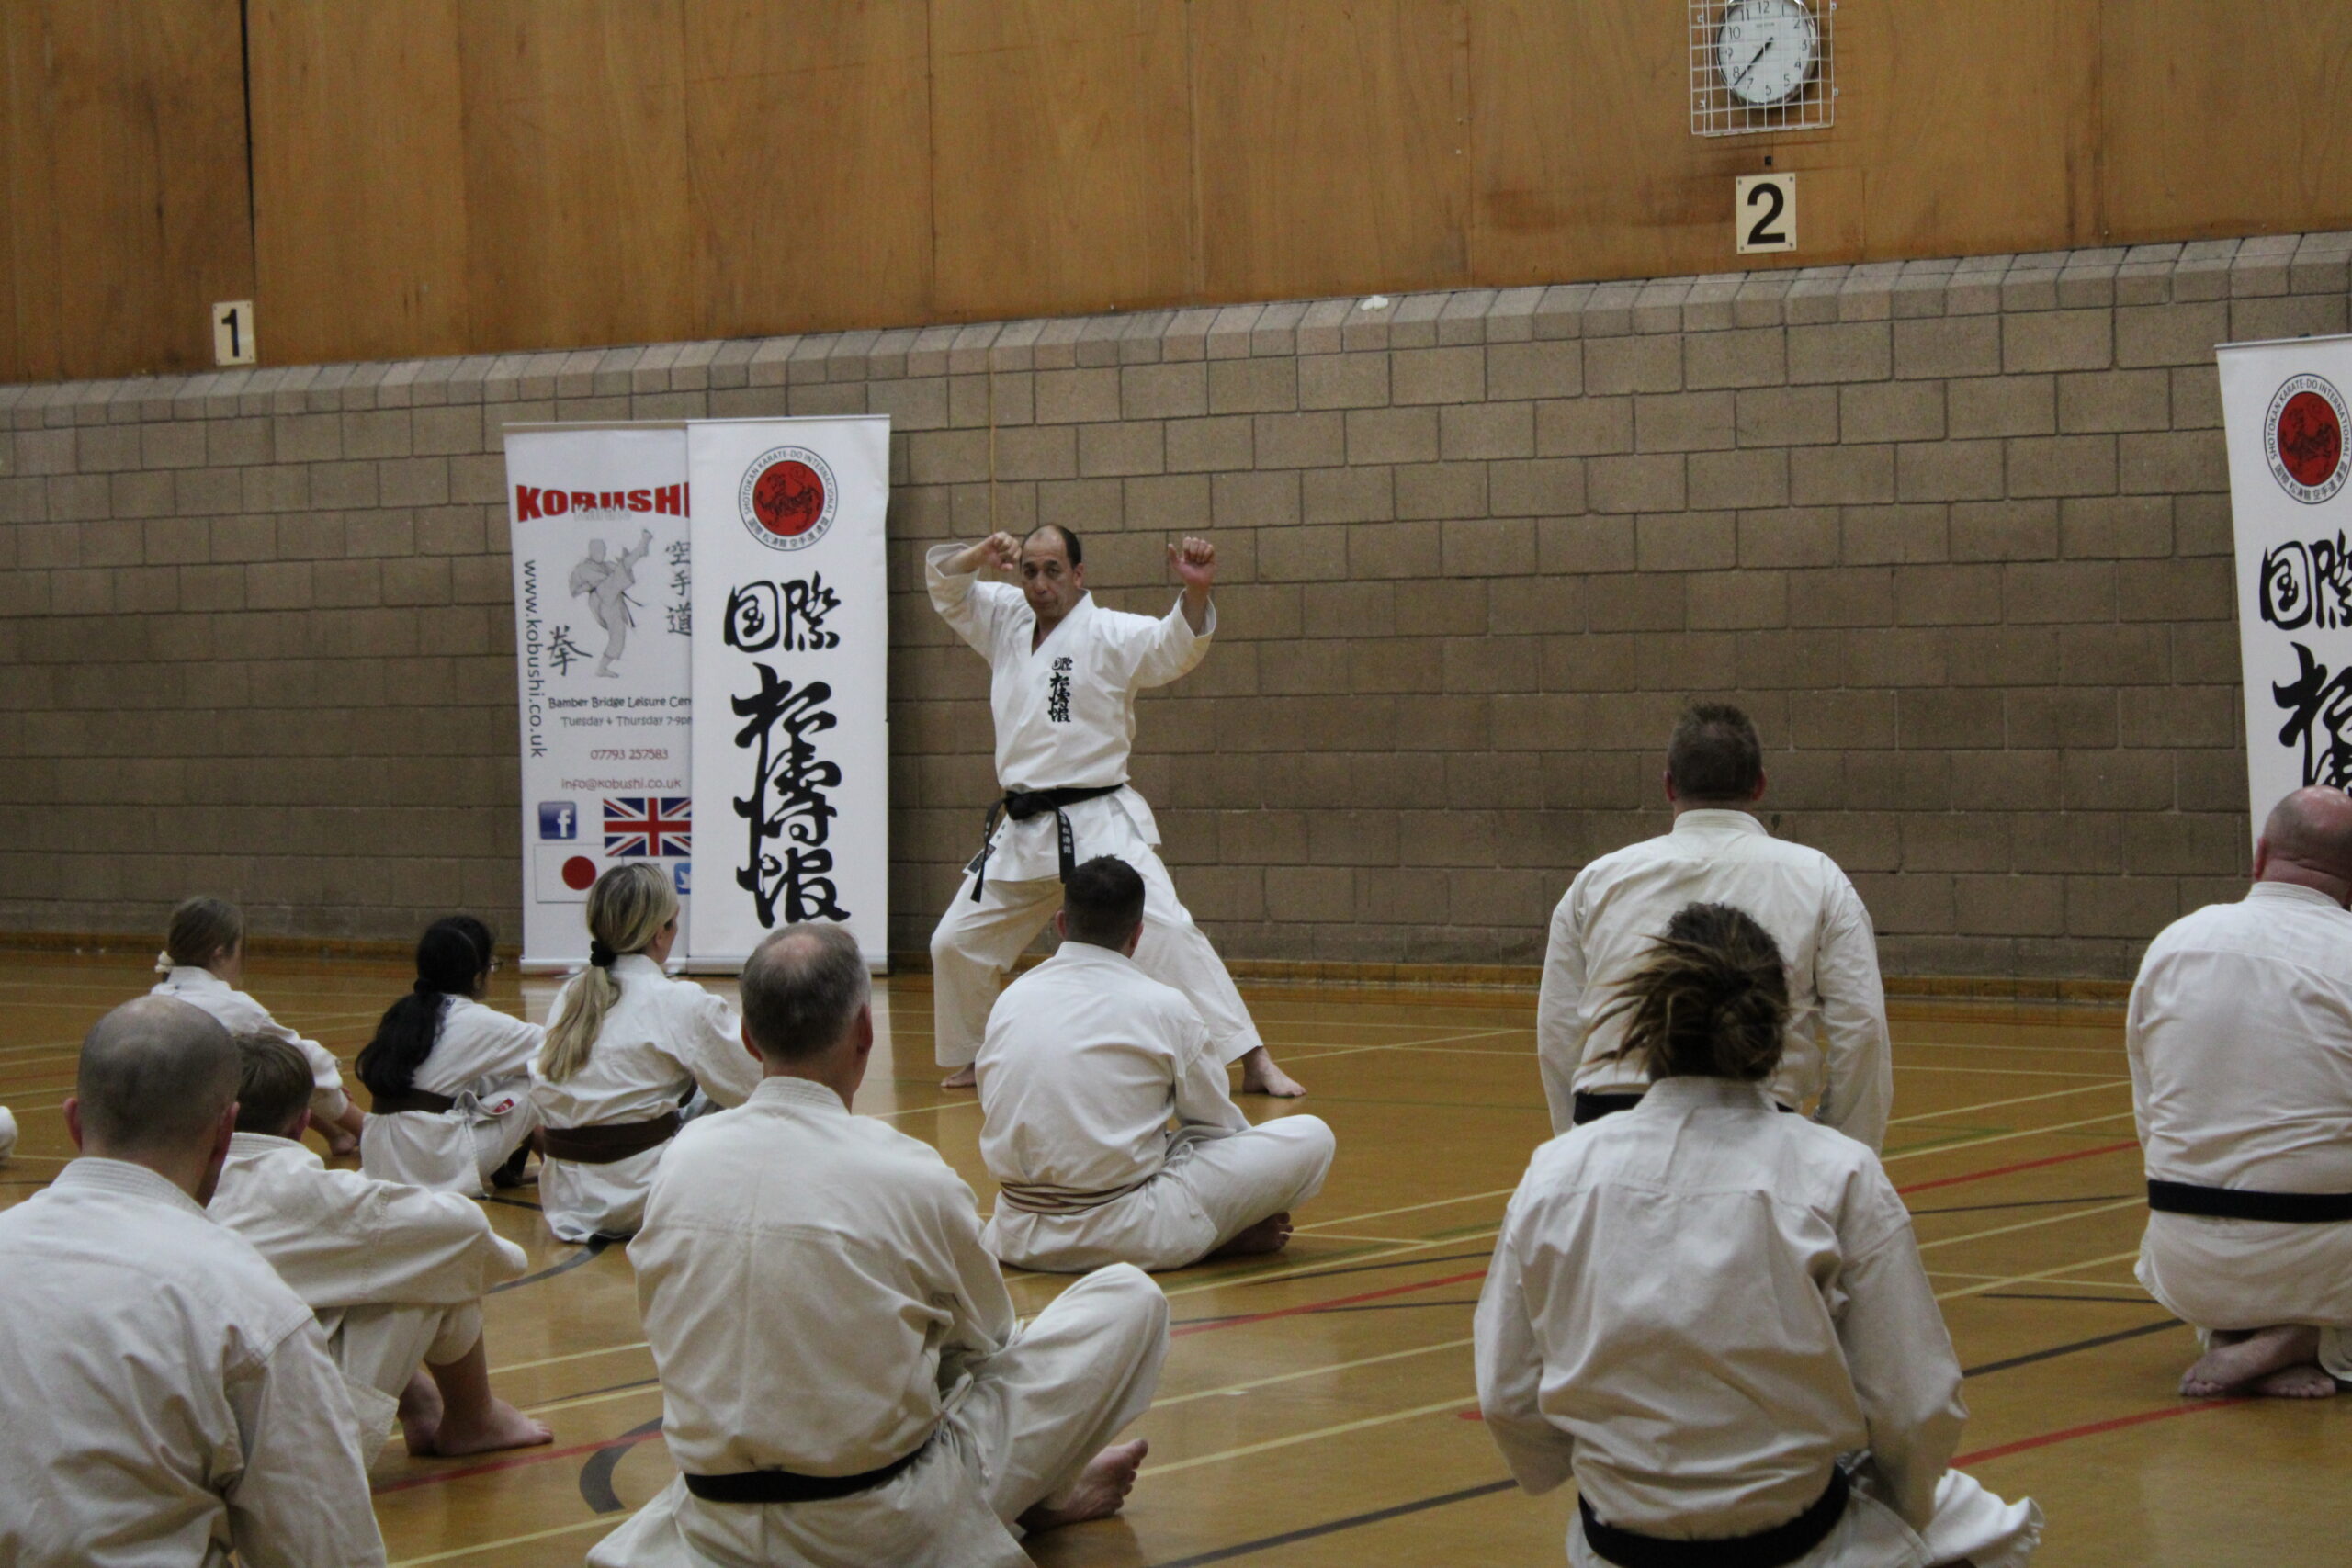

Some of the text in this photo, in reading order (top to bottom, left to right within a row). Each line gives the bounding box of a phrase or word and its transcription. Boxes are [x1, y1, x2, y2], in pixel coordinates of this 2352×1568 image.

[1758, 1, 1770, 14] 12
[1740, 8, 1750, 22] 11
[1793, 18, 1801, 29] 2
[1728, 26, 1741, 39] 10
[1794, 59, 1802, 70] 4
[1732, 66, 1740, 79] 8
[1747, 77, 1754, 90] 7
[1783, 73, 1791, 87] 5
[1747, 182, 1786, 245] 2
[221, 308, 240, 358] 1
[2267, 402, 2281, 460] SHOTOKAN
[2319, 382, 2350, 457] INTERNATIONAL
[742, 468, 759, 515] SHOTOKAN
[515, 481, 690, 523] KOBUSHI
[523, 559, 548, 759] www.kobushi.co.uk
[548, 697, 589, 710] Bamber
[591, 696, 625, 710] Bridge
[628, 696, 666, 708] Leisure
[560, 716, 604, 728] Tuesday
[616, 715, 664, 728] Thursday
[590, 748, 669, 761] 07793 257583
[561, 776, 682, 791] info@kobushi.co.uk
